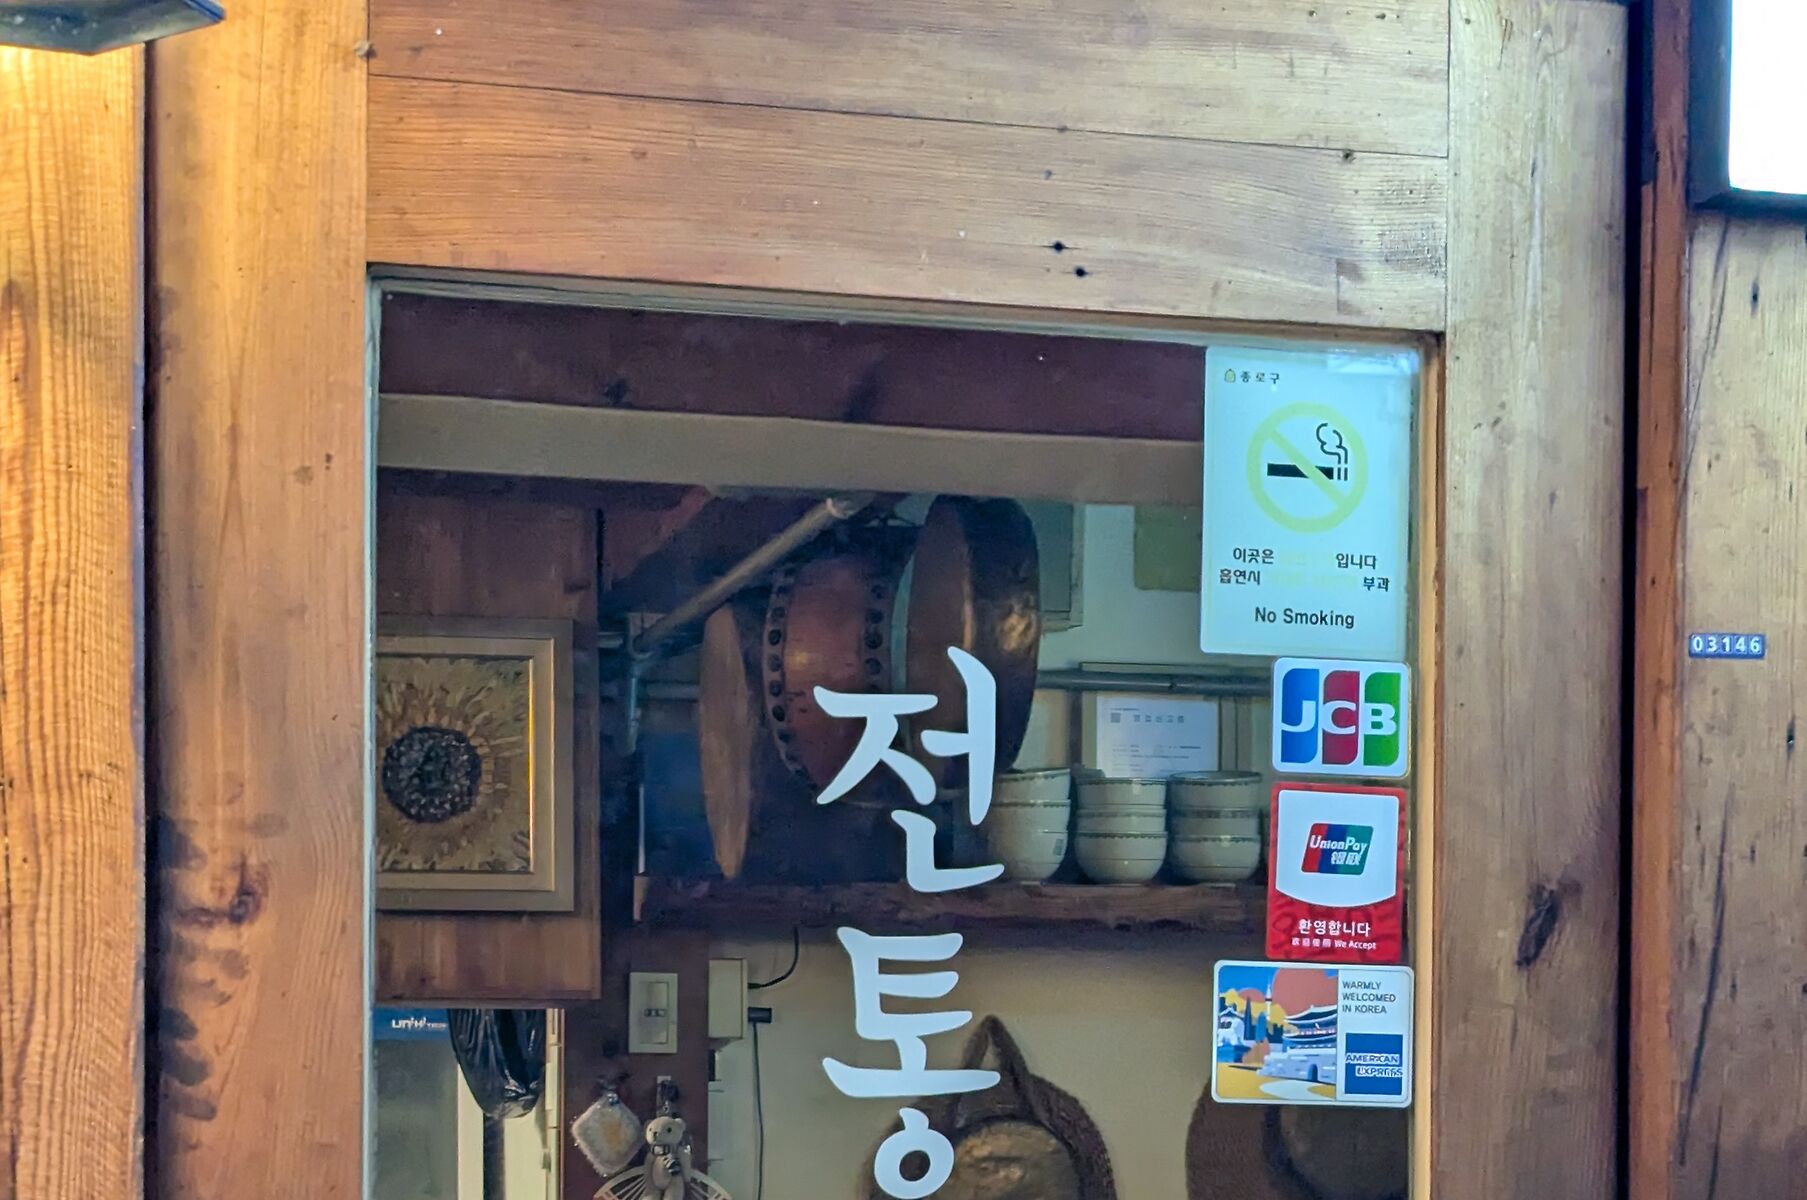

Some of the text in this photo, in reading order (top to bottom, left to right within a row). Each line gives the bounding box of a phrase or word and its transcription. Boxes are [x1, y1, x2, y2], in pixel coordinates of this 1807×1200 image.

[1240, 371, 1280, 385] 종로구
[1232, 548, 1274, 565] 이곳은
[1336, 553, 1377, 569] 입니다
[1219, 568, 1261, 585] 흡연시
[1363, 576, 1390, 592] 부과
[1254, 607, 1355, 629] No Smoking
[1692, 636, 1762, 653] 03146
[1309, 834, 1368, 856] UnionPay
[1298, 918, 1371, 937] 환영합니다
[1334, 939, 1347, 949] We
[1348, 940, 1377, 951] Accept
[1342, 980, 1382, 991] WARMLY
[1342, 992, 1396, 1003] WELCOMED
[1342, 1004, 1387, 1014] IN KOREA
[1345, 1053, 1400, 1065] AMERICAN
